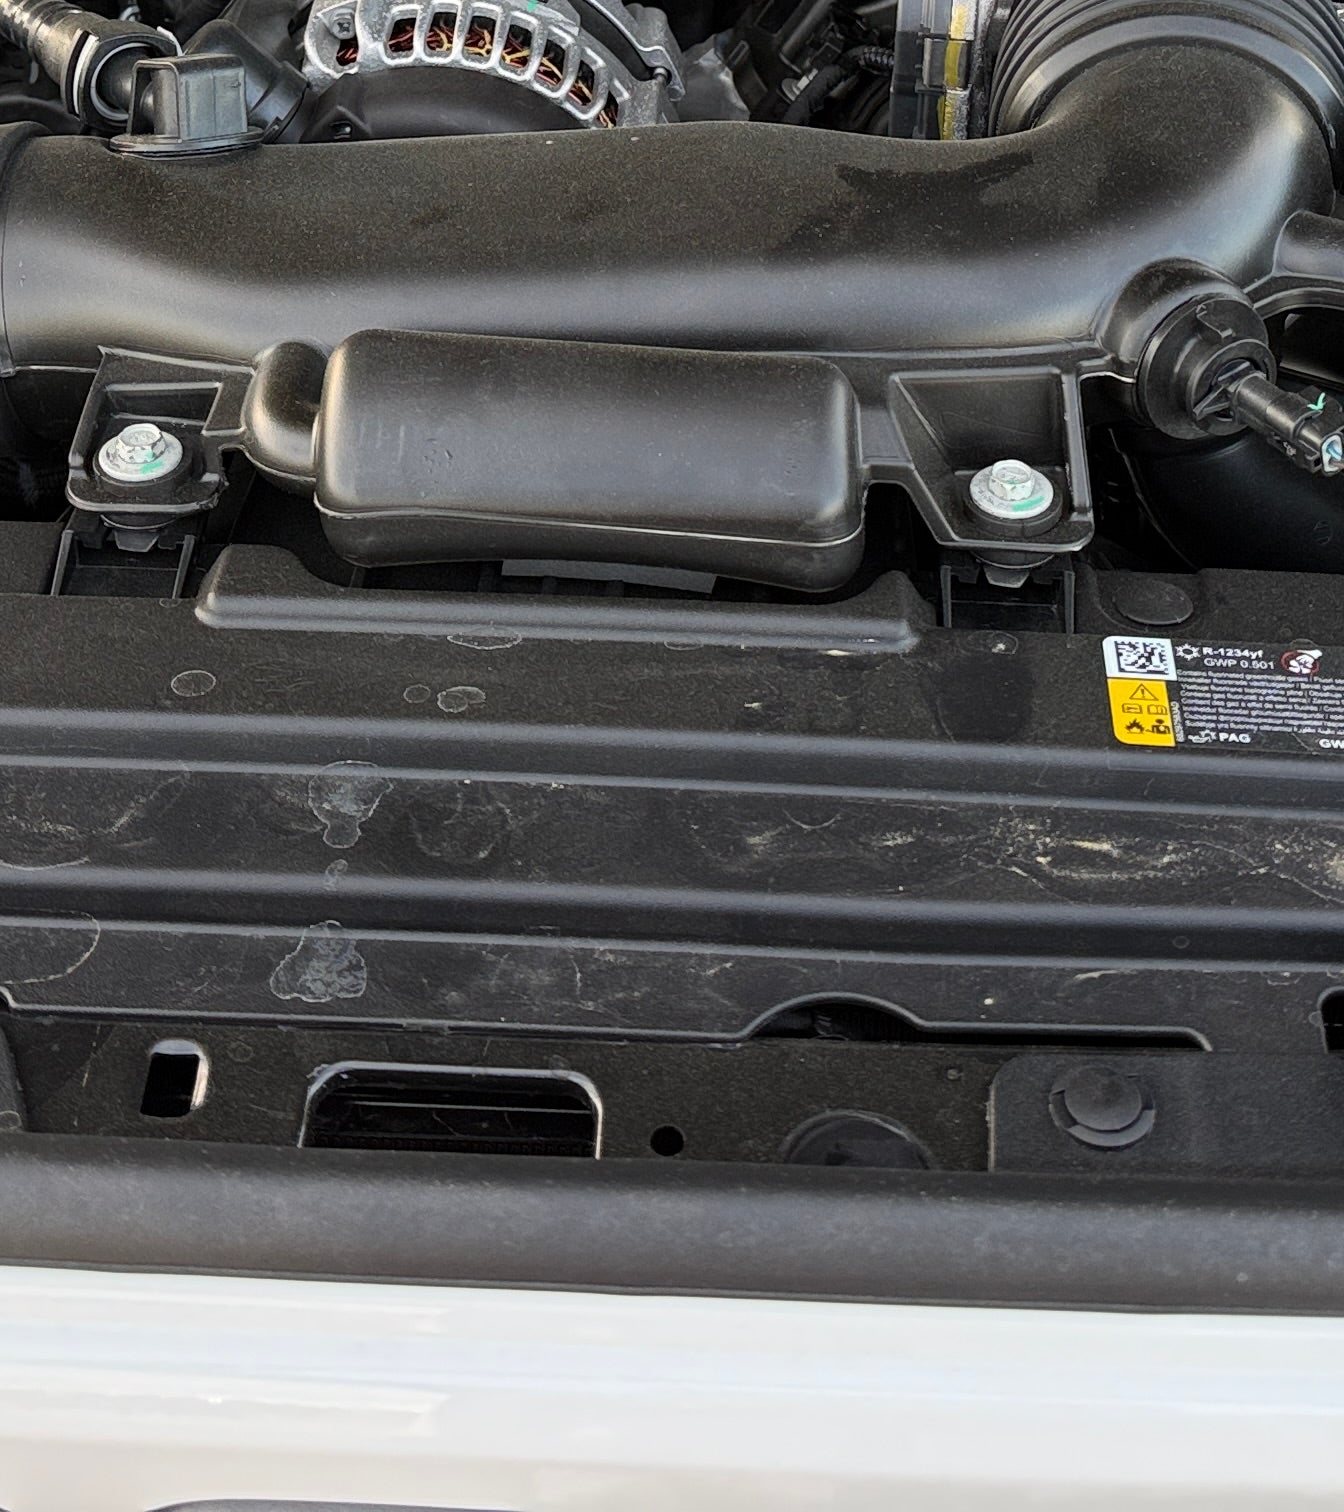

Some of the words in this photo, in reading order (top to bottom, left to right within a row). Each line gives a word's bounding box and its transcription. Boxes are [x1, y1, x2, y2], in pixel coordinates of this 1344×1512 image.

[1202, 647, 1263, 659] R-1234yf
[1203, 658, 1237, 667] GWP
[1218, 732, 1251, 744] PAG
